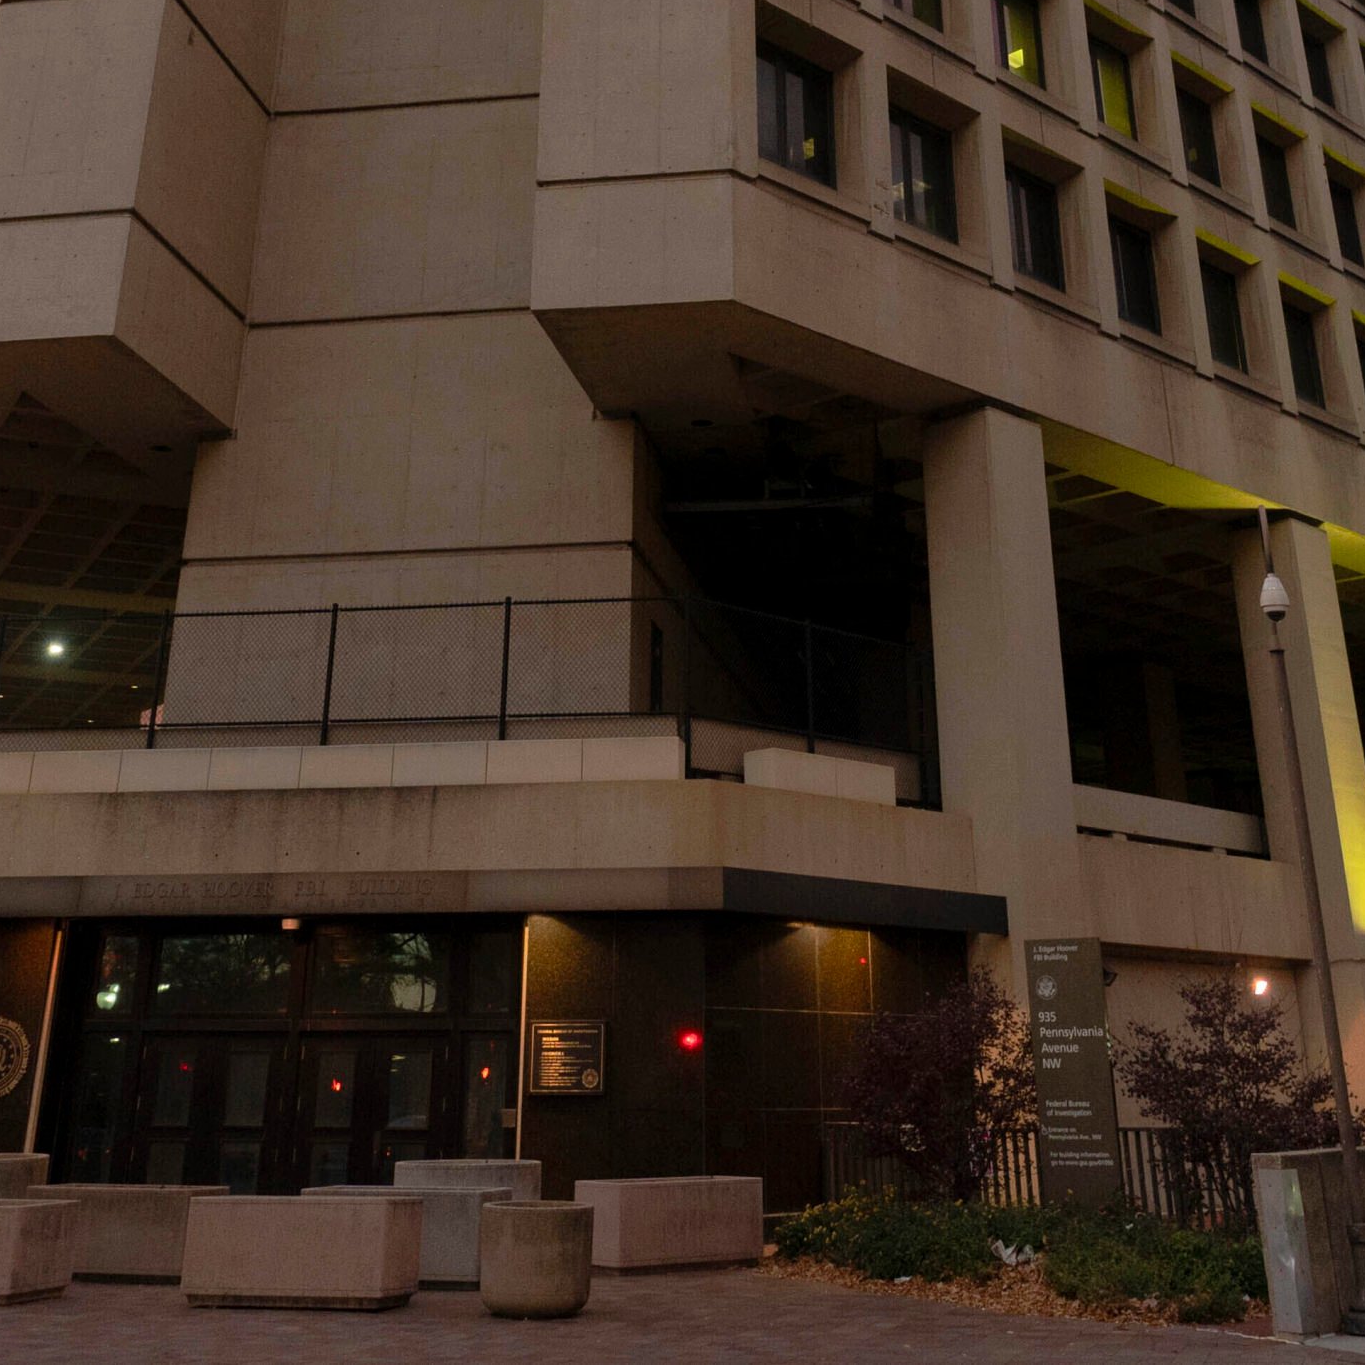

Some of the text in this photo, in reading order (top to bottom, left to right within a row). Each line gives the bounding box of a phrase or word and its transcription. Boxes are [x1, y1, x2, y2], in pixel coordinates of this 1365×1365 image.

[1039, 945, 1056, 954] Edgar
[1043, 953, 1068, 962] Building
[1038, 1011, 1056, 1023] 935
[1039, 1026, 1104, 1039] Pennsylvania
[1041, 1042, 1080, 1053] Avenue
[1042, 1058, 1062, 1069] NW
[1045, 1099, 1090, 1108] Federal Bureau
[1054, 1109, 1093, 1118] Investigation
